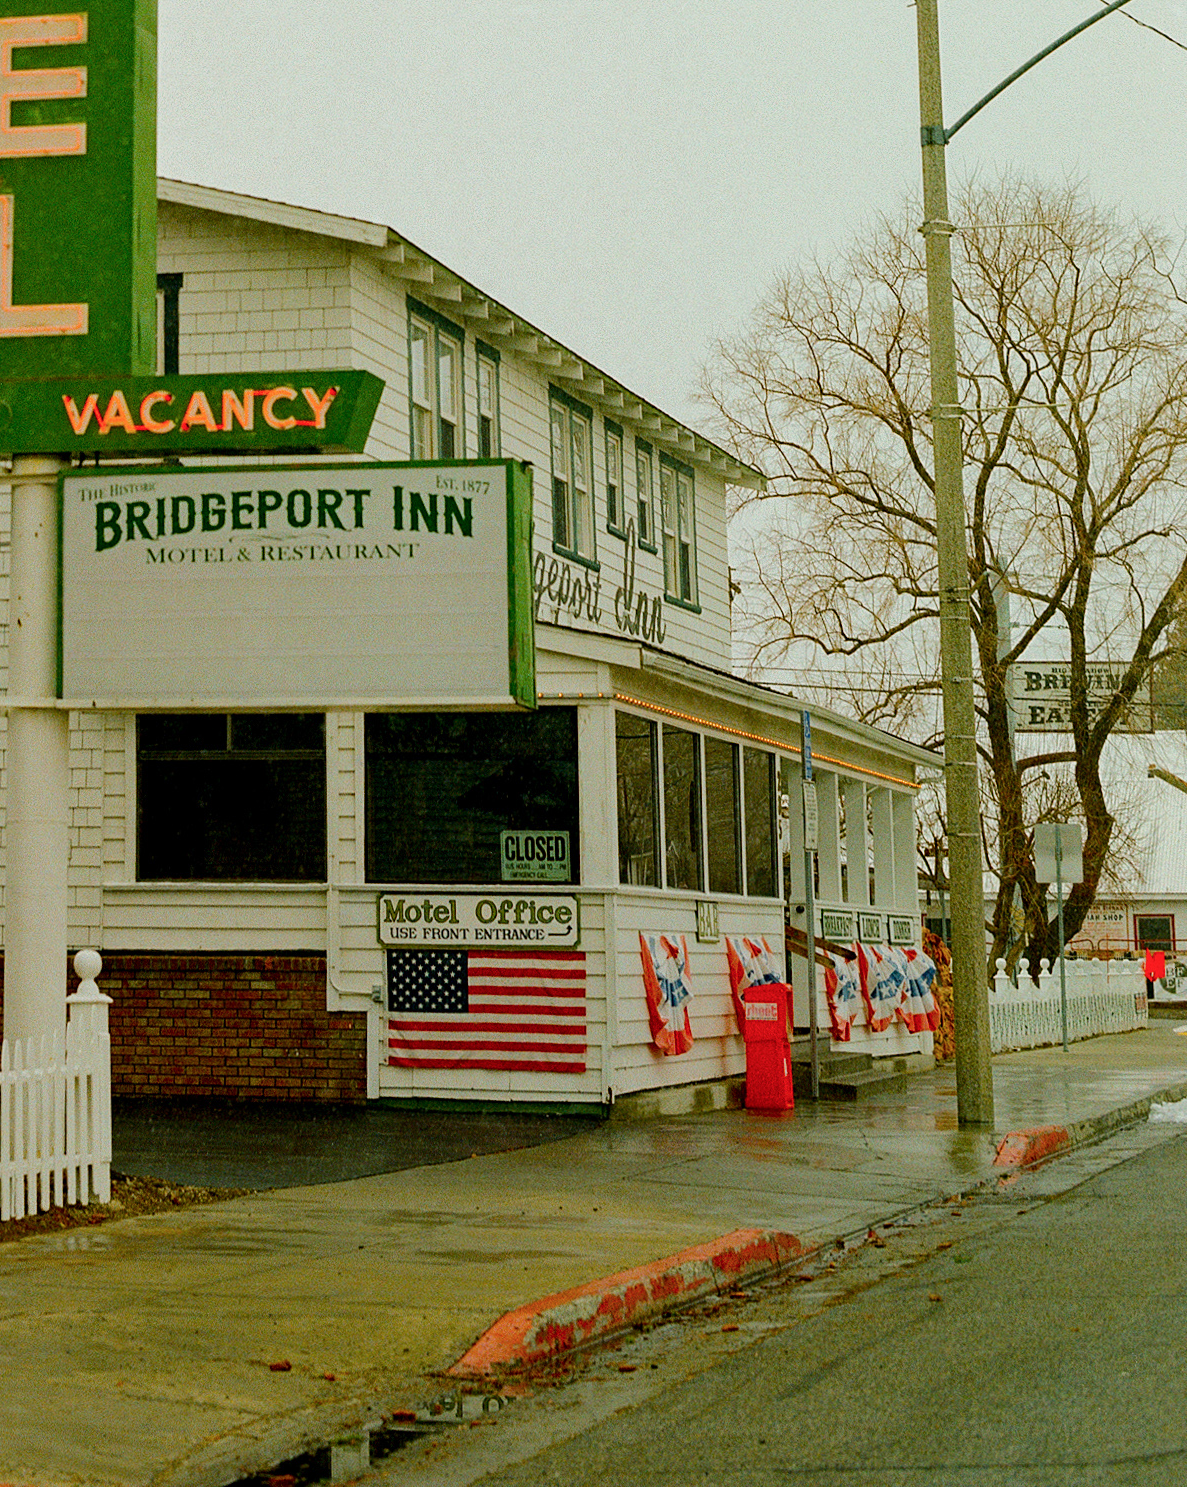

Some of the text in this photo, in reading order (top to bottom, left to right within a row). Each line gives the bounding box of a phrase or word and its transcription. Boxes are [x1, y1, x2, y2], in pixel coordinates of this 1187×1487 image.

[62, 385, 341, 435] VACANCY
[79, 487, 103, 502] THE
[462, 480, 491, 495] 1877
[95, 485, 474, 553] BRIDGEPORT INN
[146, 544, 421, 564] MOTEL & RESTAURANT
[504, 835, 566, 862] CLOSED
[383, 899, 573, 925] Motel Office
[699, 901, 719, 938] BAR
[389, 927, 545, 941] USE FRONT ENTRANCE
